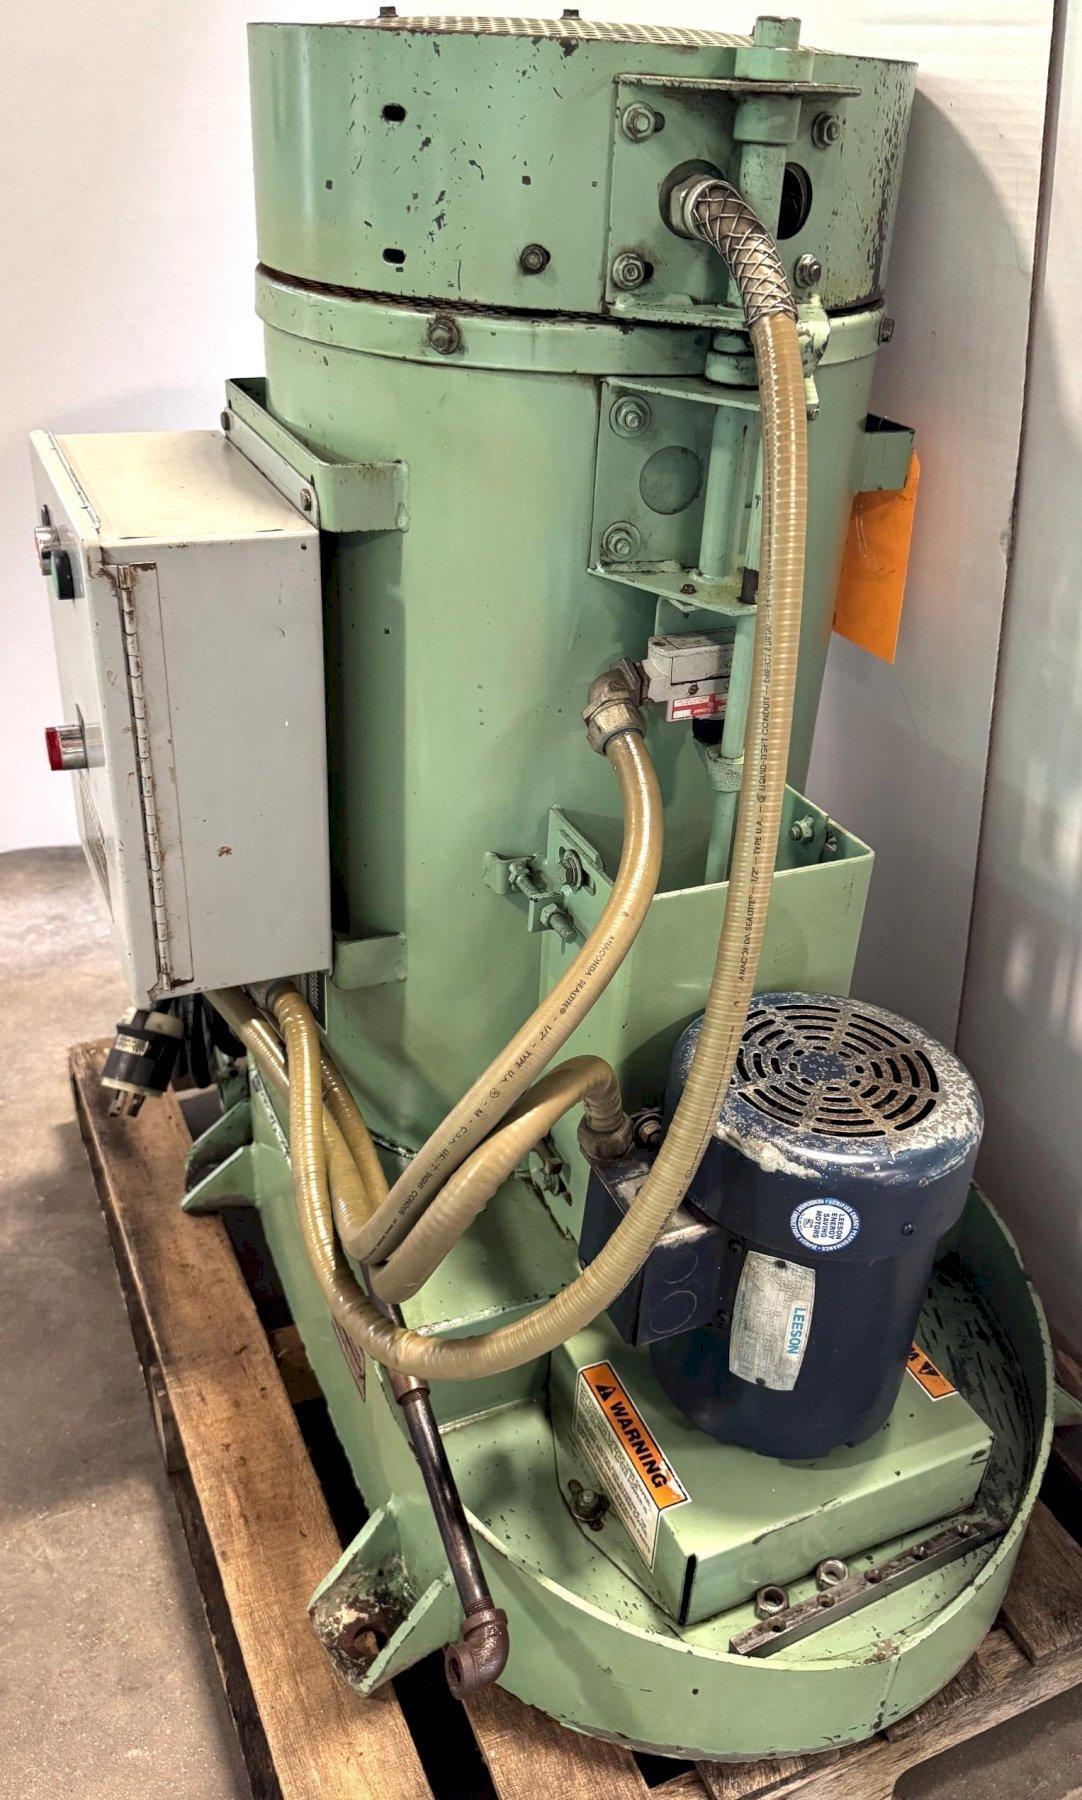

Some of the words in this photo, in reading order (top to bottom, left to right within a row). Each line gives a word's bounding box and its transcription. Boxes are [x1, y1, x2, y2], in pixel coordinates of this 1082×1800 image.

[739, 934, 751, 982] ANACONDA
[753, 837, 762, 854] TYPE
[761, 696, 770, 735] CONDUIT
[586, 935, 615, 976] ANACONDA
[514, 1052, 533, 1069] TYPE
[812, 1210, 823, 1239] MOTORS
[820, 1213, 830, 1238] SAVING
[828, 1212, 838, 1240] ENERGY
[836, 1213, 845, 1240] LEESON
[787, 1307, 807, 1355] LEESON
[610, 1401, 667, 1488] WARNING
